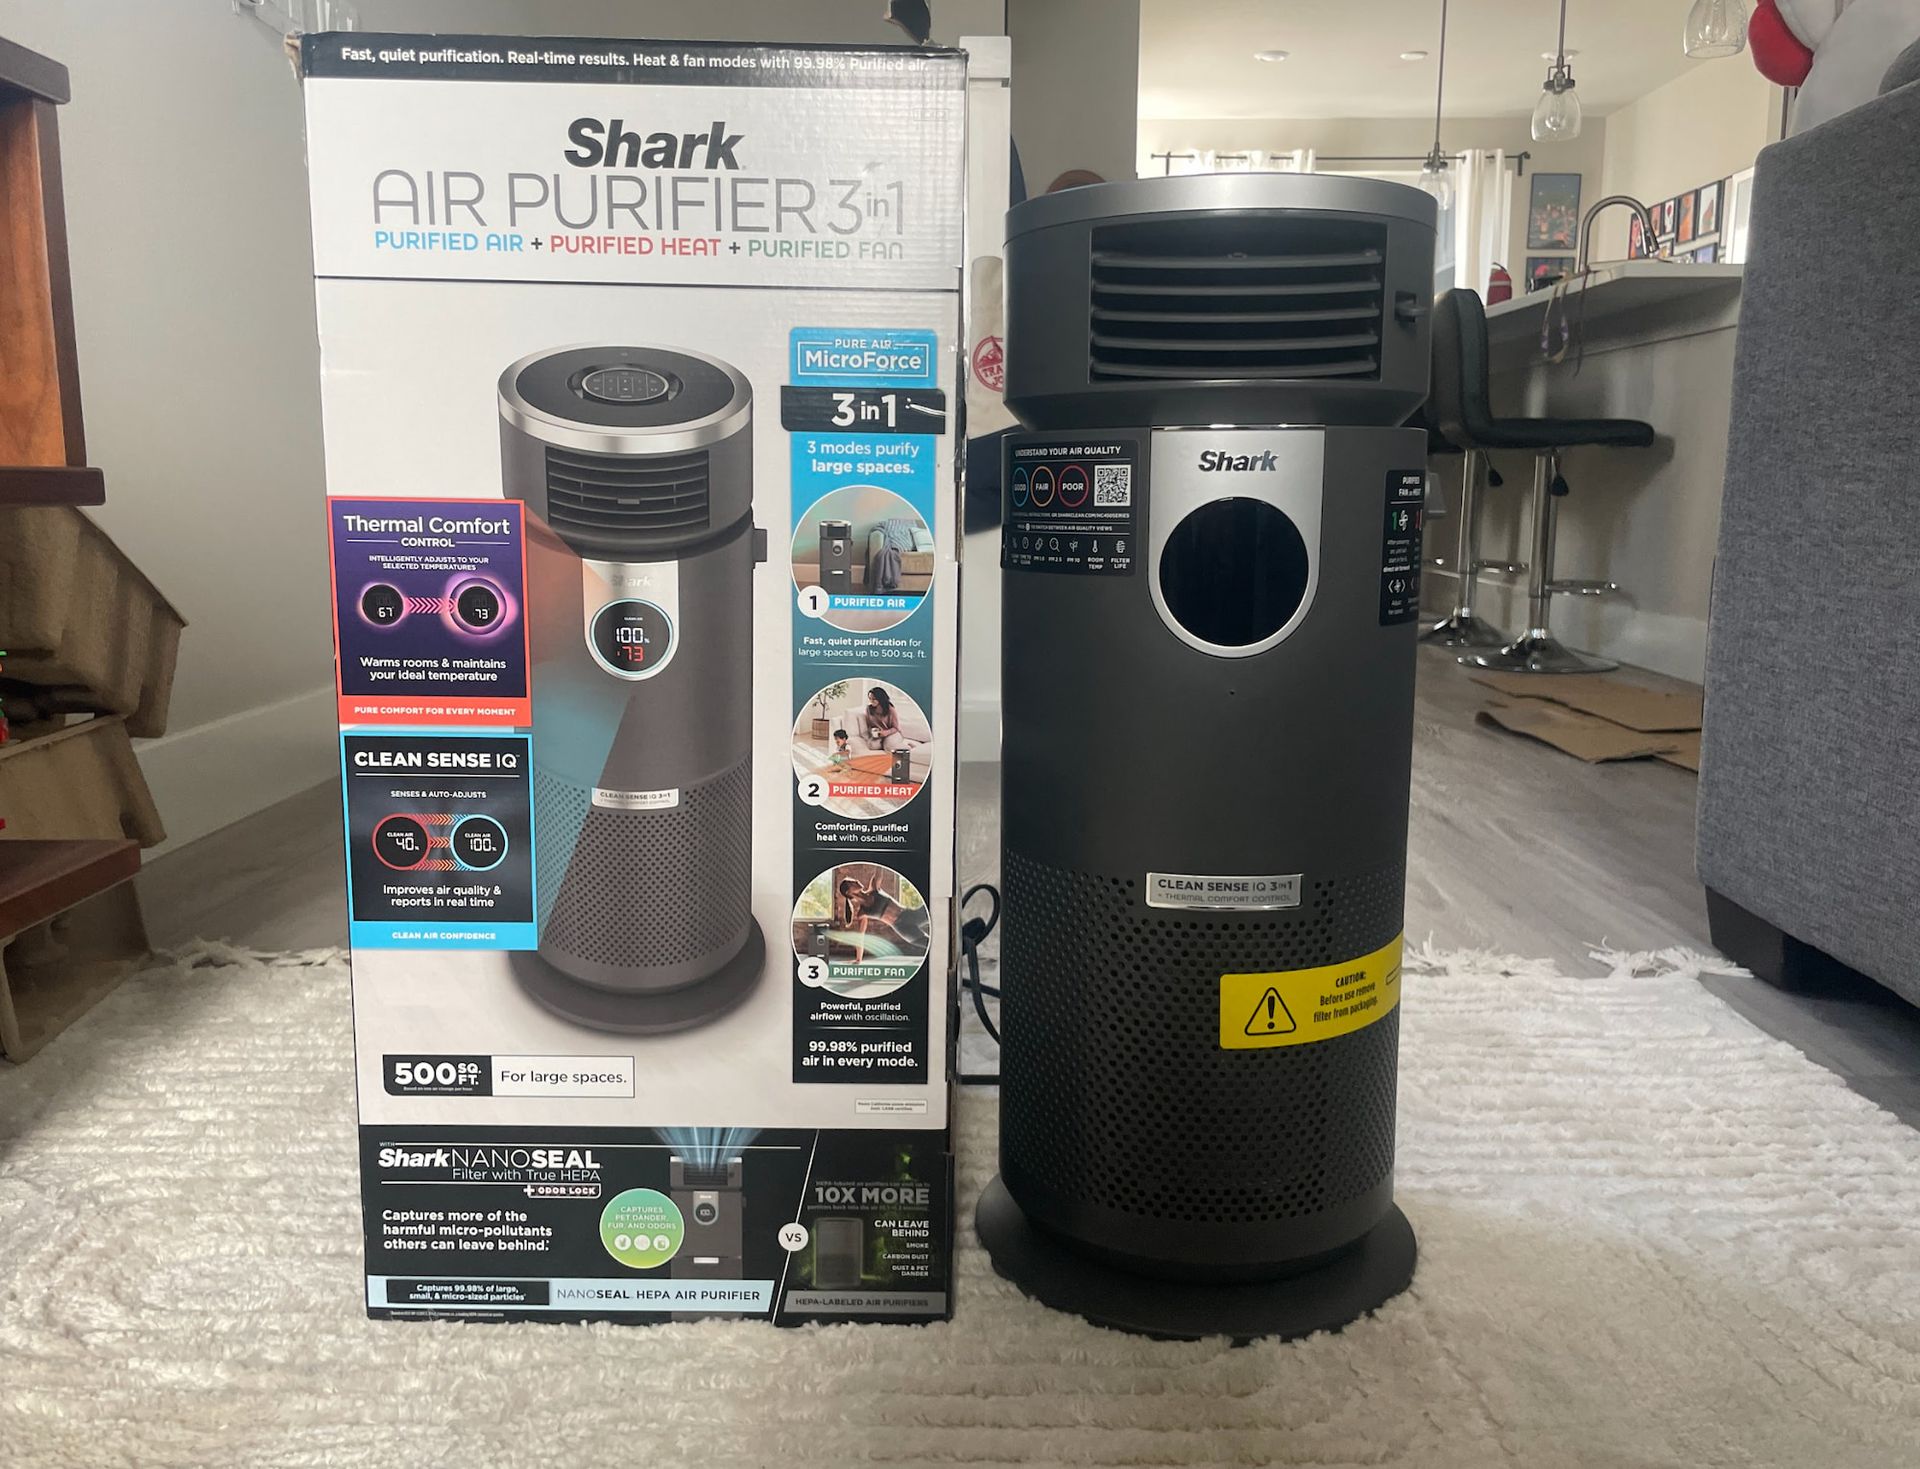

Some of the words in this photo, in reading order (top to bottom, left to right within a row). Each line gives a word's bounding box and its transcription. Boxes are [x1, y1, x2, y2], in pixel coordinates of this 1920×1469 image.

[342, 48, 376, 62] Fast,
[379, 50, 415, 63] quiet
[419, 50, 504, 65] purification.
[508, 52, 575, 64] Real-time
[579, 53, 629, 66] results.
[633, 54, 666, 67] Heat
[669, 55, 680, 67] &
[683, 54, 705, 67] fan
[709, 55, 756, 68] modes
[760, 56, 790, 69] with
[794, 57, 845, 69] 99.98%
[850, 58, 903, 71] Purified
[908, 59, 929, 71] air.
[564, 117, 744, 170] Shark
[373, 169, 487, 227] AIR
[508, 173, 816, 234] PURIFIER
[375, 231, 478, 251] PURIFIED
[486, 233, 524, 251] AIR
[530, 237, 543, 250] +
[551, 235, 654, 255] PURIFIED
[661, 237, 721, 256] HEAT
[729, 242, 741, 254] +
[748, 239, 850, 258] PURIFIED
[859, 242, 903, 259] FAN
[834, 338, 867, 349] PURE
[871, 340, 892, 350] AIR
[805, 350, 921, 370] MicroForce
[807, 441, 816, 454] 3
[820, 441, 871, 455] modes
[876, 442, 919, 458] purify
[1049, 448, 1068, 456] YOUR
[1069, 447, 1082, 455] AIR
[1084, 446, 1121, 455] QUALITY
[812, 458, 853, 475] large
[857, 461, 915, 476] spaces.
[1198, 450, 1279, 472] Shark
[1035, 483, 1049, 491] FAIR
[1062, 482, 1084, 491] POOR
[343, 515, 423, 533] Thermal
[428, 517, 511, 535] Comfort
[401, 537, 455, 548] CONTROL
[834, 598, 884, 607] PURIFIED
[887, 599, 906, 608] AIR
[360, 656, 401, 668] Warms
[403, 658, 439, 668] rooms
[441, 658, 450, 668] &
[453, 658, 507, 669] maintains
[370, 671, 396, 682] your
[398, 670, 425, 681] ideal
[428, 671, 498, 683] temperature
[354, 706, 378, 714] PURE
[380, 707, 423, 715] COMFORT
[426, 707, 444, 715] FOR
[446, 707, 475, 716] EVERY
[477, 708, 516, 716] MOMENT
[354, 752, 422, 767] CLEAN
[427, 753, 492, 768] SENSE
[808, 783, 820, 797] 2
[832, 785, 881, 795] PURIFIED
[885, 786, 913, 796] HEAT
[815, 823, 871, 833] Comforting,
[872, 824, 909, 833] purified
[816, 833, 837, 842] heat
[839, 833, 858, 842] with
[860, 834, 907, 843] oscillation.
[383, 885, 434, 895] Improves
[437, 885, 451, 895] air
[453, 885, 491, 896] quality
[494, 886, 501, 895] &
[1158, 879, 1203, 891] CLEAN
[1207, 881, 1248, 892] SENSE
[1252, 881, 1266, 892] IQ
[391, 897, 431, 908] reports
[434, 897, 444, 906] in
[447, 897, 467, 907] real
[470, 897, 495, 907] time
[808, 965, 820, 979] 3
[833, 967, 881, 977] PURIFIED
[884, 968, 906, 977] FAN
[1320, 993, 1343, 1006] Before
[1344, 989, 1355, 1000] use
[820, 1002, 863, 1012] Powerful,
[865, 1003, 901, 1013] purified
[810, 1012, 842, 1021] airflow
[844, 1013, 863, 1021] with
[864, 1013, 910, 1022] oscillation.
[1313, 1011, 1331, 1023] filter
[1334, 1006, 1349, 1019] from
[809, 1041, 858, 1052] 99.98%
[860, 1041, 912, 1054] purified
[802, 1056, 820, 1066] air
[822, 1056, 835, 1067] in
[838, 1057, 873, 1069] every
[877, 1056, 918, 1068] mode.
[394, 1062, 457, 1086] 500
[457, 1062, 481, 1075] SQ.
[458, 1074, 479, 1086] FT.
[501, 1070, 526, 1083] For
[531, 1070, 568, 1087] large
[572, 1071, 627, 1087] spaces.
[378, 1148, 450, 1168] Shark
[452, 1149, 600, 1169] NANOSEAL
[452, 1168, 487, 1180] Filter
[491, 1168, 522, 1181] with
[525, 1169, 556, 1181] True
[560, 1170, 601, 1182] HEPA
[815, 1186, 856, 1203] 10X
[862, 1187, 930, 1205] MORE
[382, 1209, 444, 1222] Captures
[448, 1211, 483, 1222] more
[487, 1210, 502, 1222] of
[504, 1211, 528, 1222] the
[874, 1219, 896, 1229] CAN
[898, 1219, 929, 1229] LEAVE
[383, 1224, 436, 1236] harmful
[439, 1224, 552, 1238] micro-pollutants
[892, 1229, 929, 1238] BEHIND
[383, 1239, 427, 1250] others
[430, 1240, 455, 1250] can
[459, 1239, 494, 1251] leave
[636, 1290, 670, 1299] HEPA
[675, 1290, 697, 1300] AIR
[701, 1291, 760, 1301] PURIFIER
